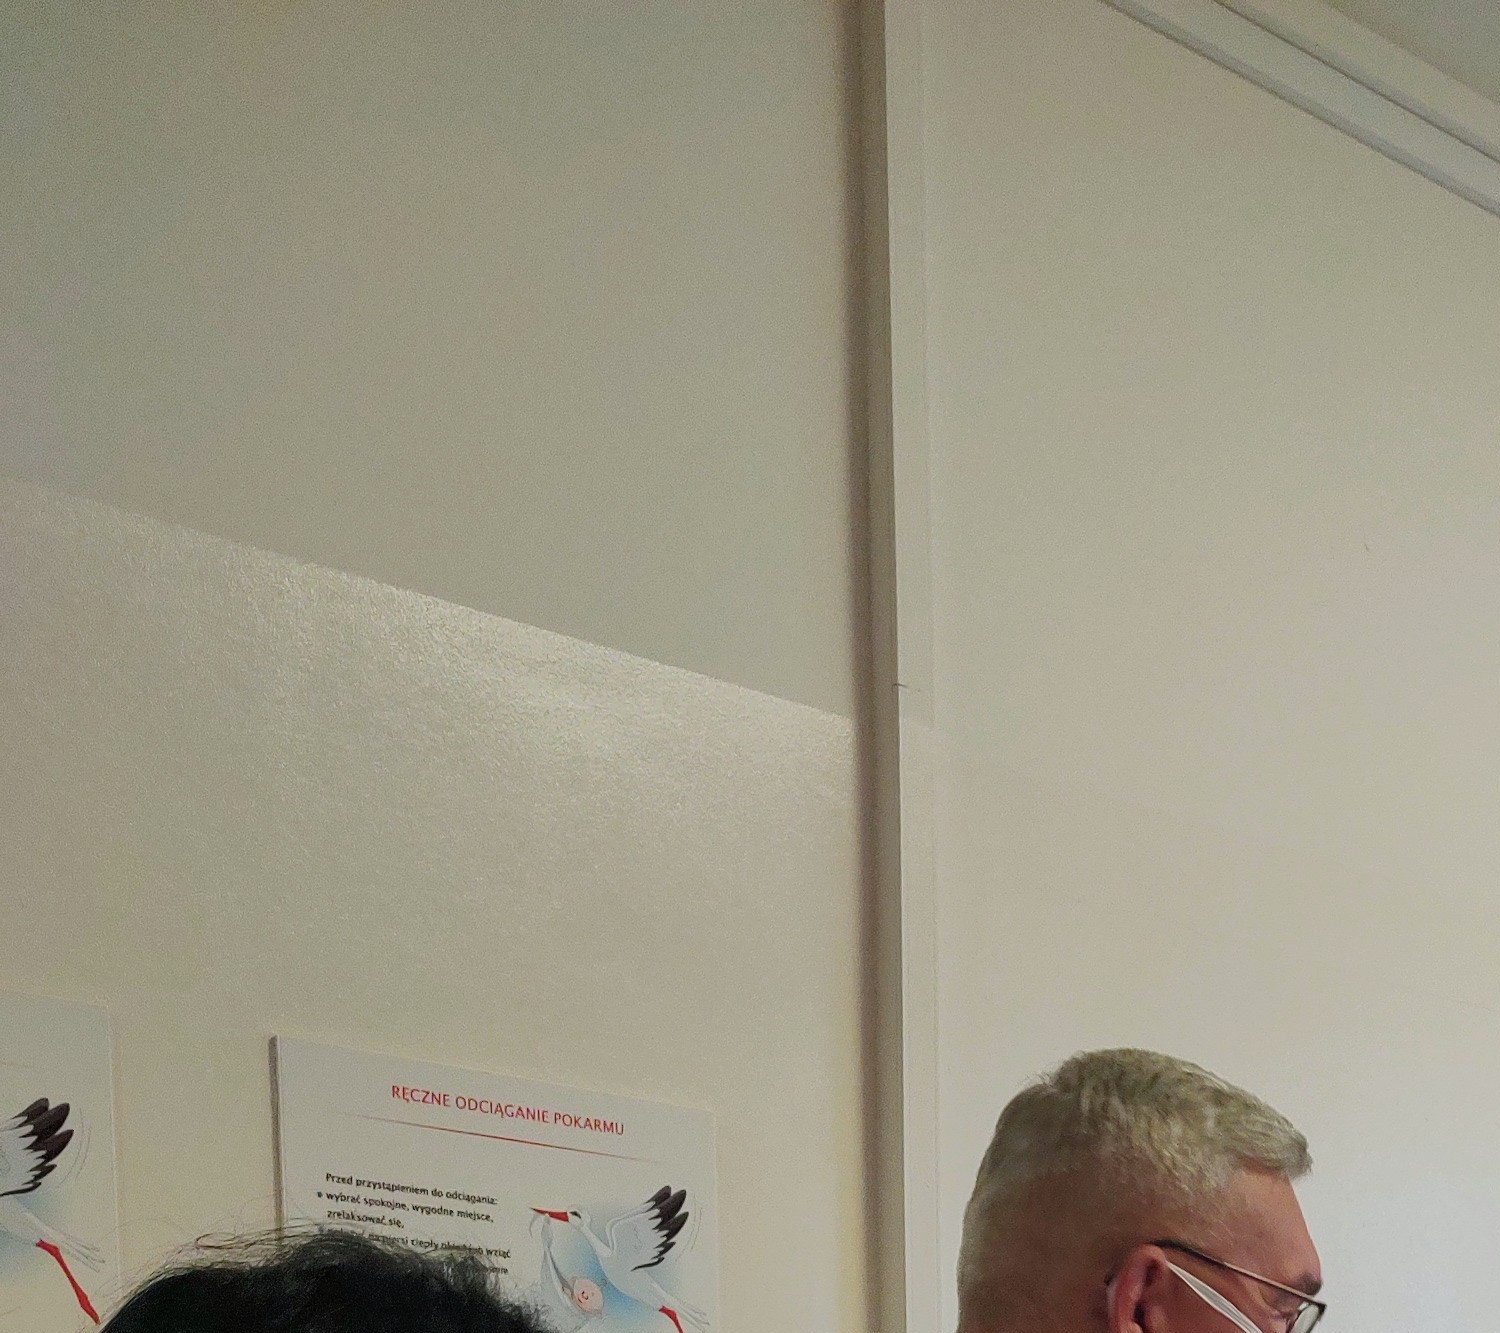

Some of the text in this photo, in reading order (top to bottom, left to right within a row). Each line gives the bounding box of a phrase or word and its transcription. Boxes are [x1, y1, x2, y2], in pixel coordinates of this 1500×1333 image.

[391, 1084, 625, 1136] RĘCZNE ODCIĄGANIE POKARMU
[326, 1172, 353, 1185] Przed
[431, 1188, 443, 1197] do
[364, 1197, 409, 1211] spokojne,
[412, 1203, 454, 1217] wygodne
[457, 1209, 494, 1223] miejsce,
[388, 1217, 404, 1229] się,
